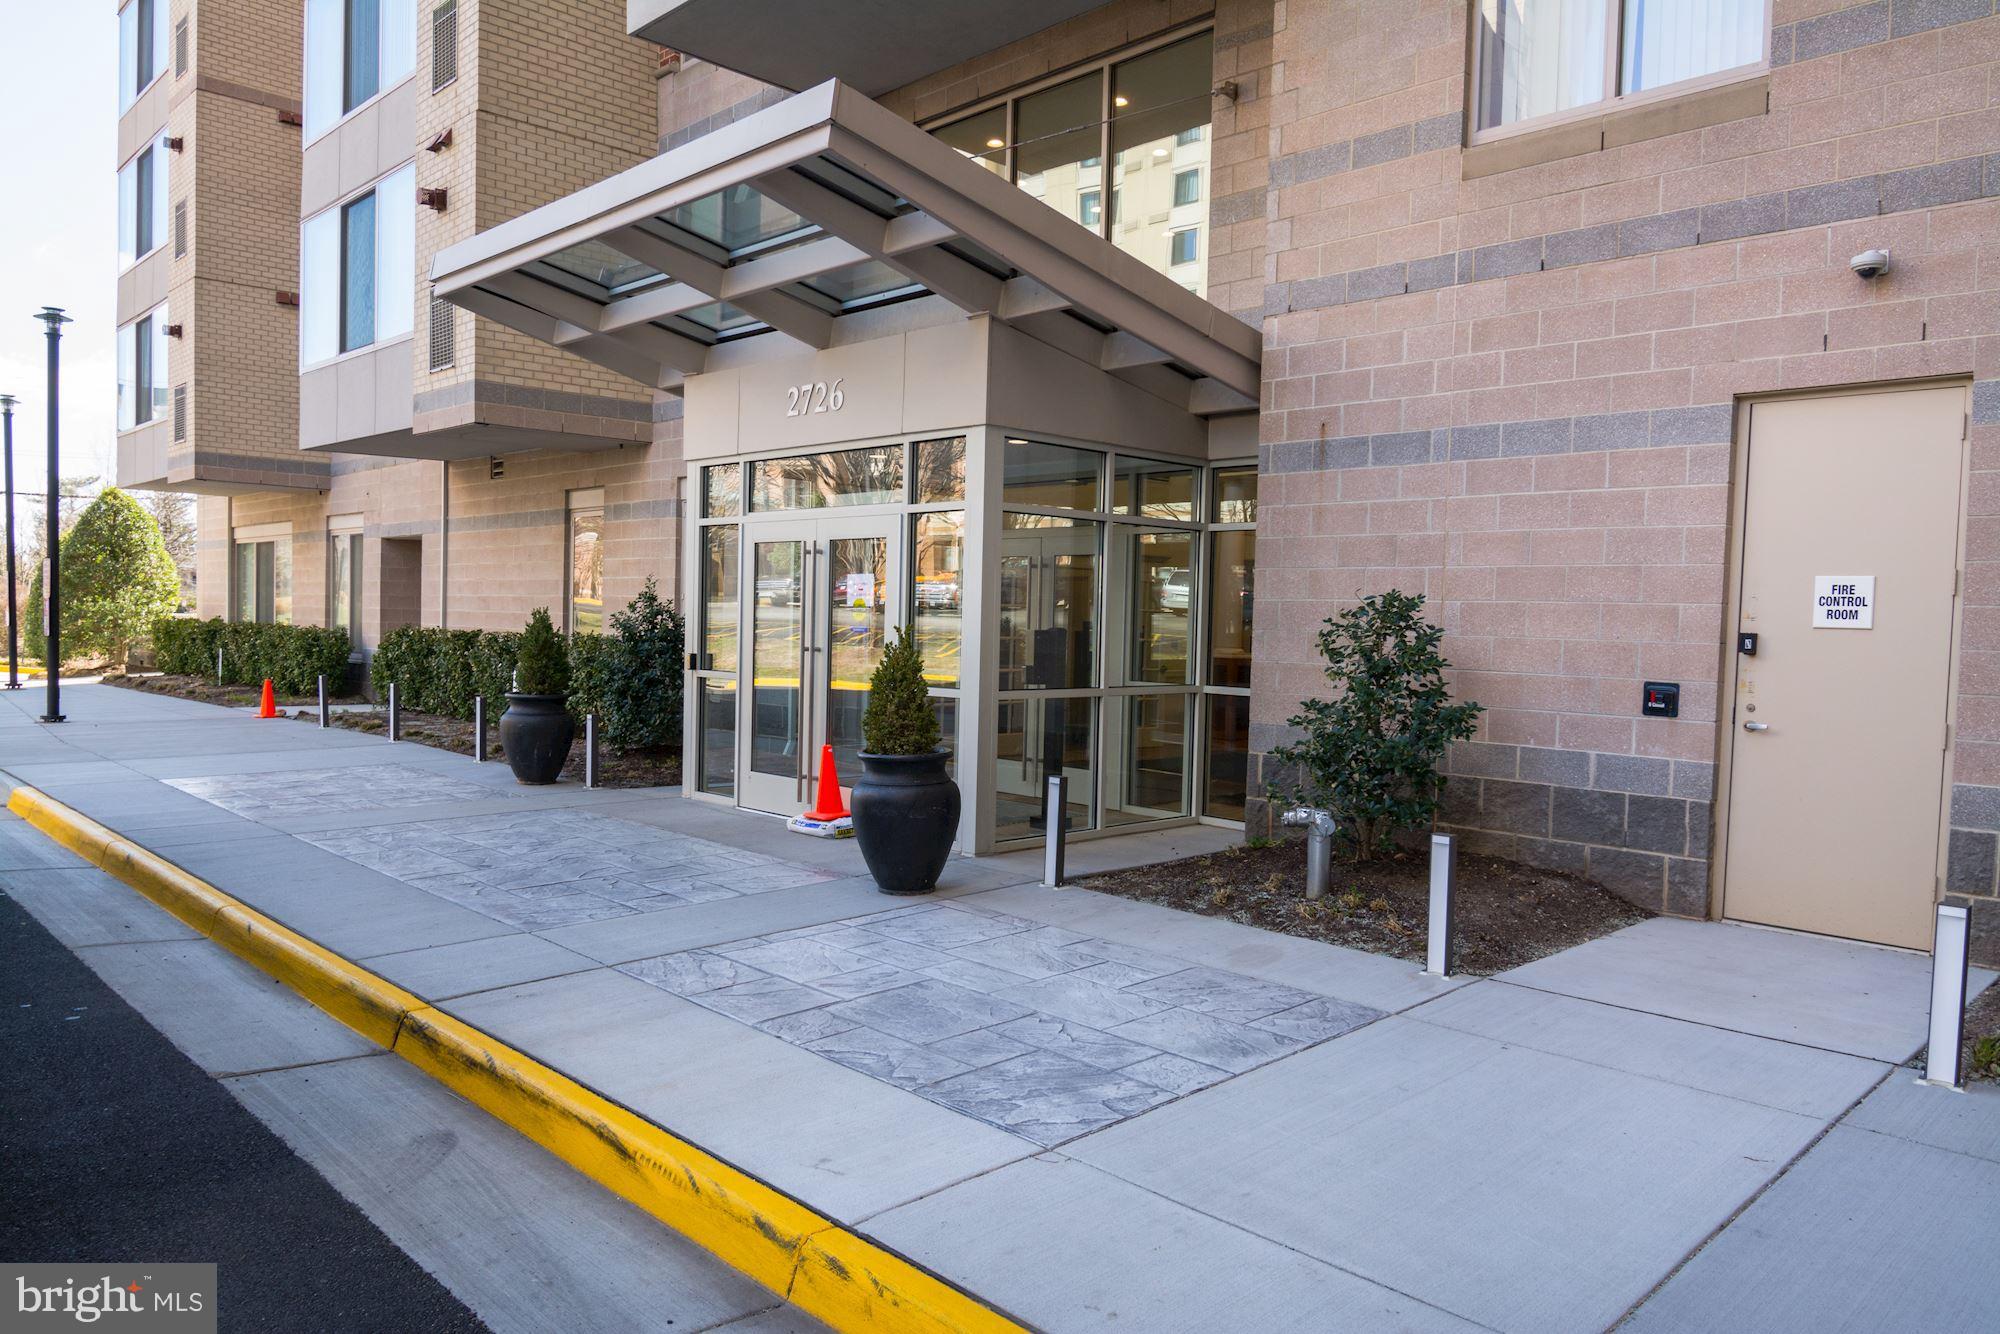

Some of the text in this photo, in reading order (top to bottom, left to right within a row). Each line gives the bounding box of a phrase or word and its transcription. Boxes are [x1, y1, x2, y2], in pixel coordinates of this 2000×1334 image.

[787, 378, 845, 417] 2726
[1831, 584, 1856, 595] FIRE
[1818, 596, 1868, 607] CONTROL
[1826, 609, 1859, 620] ROOM
